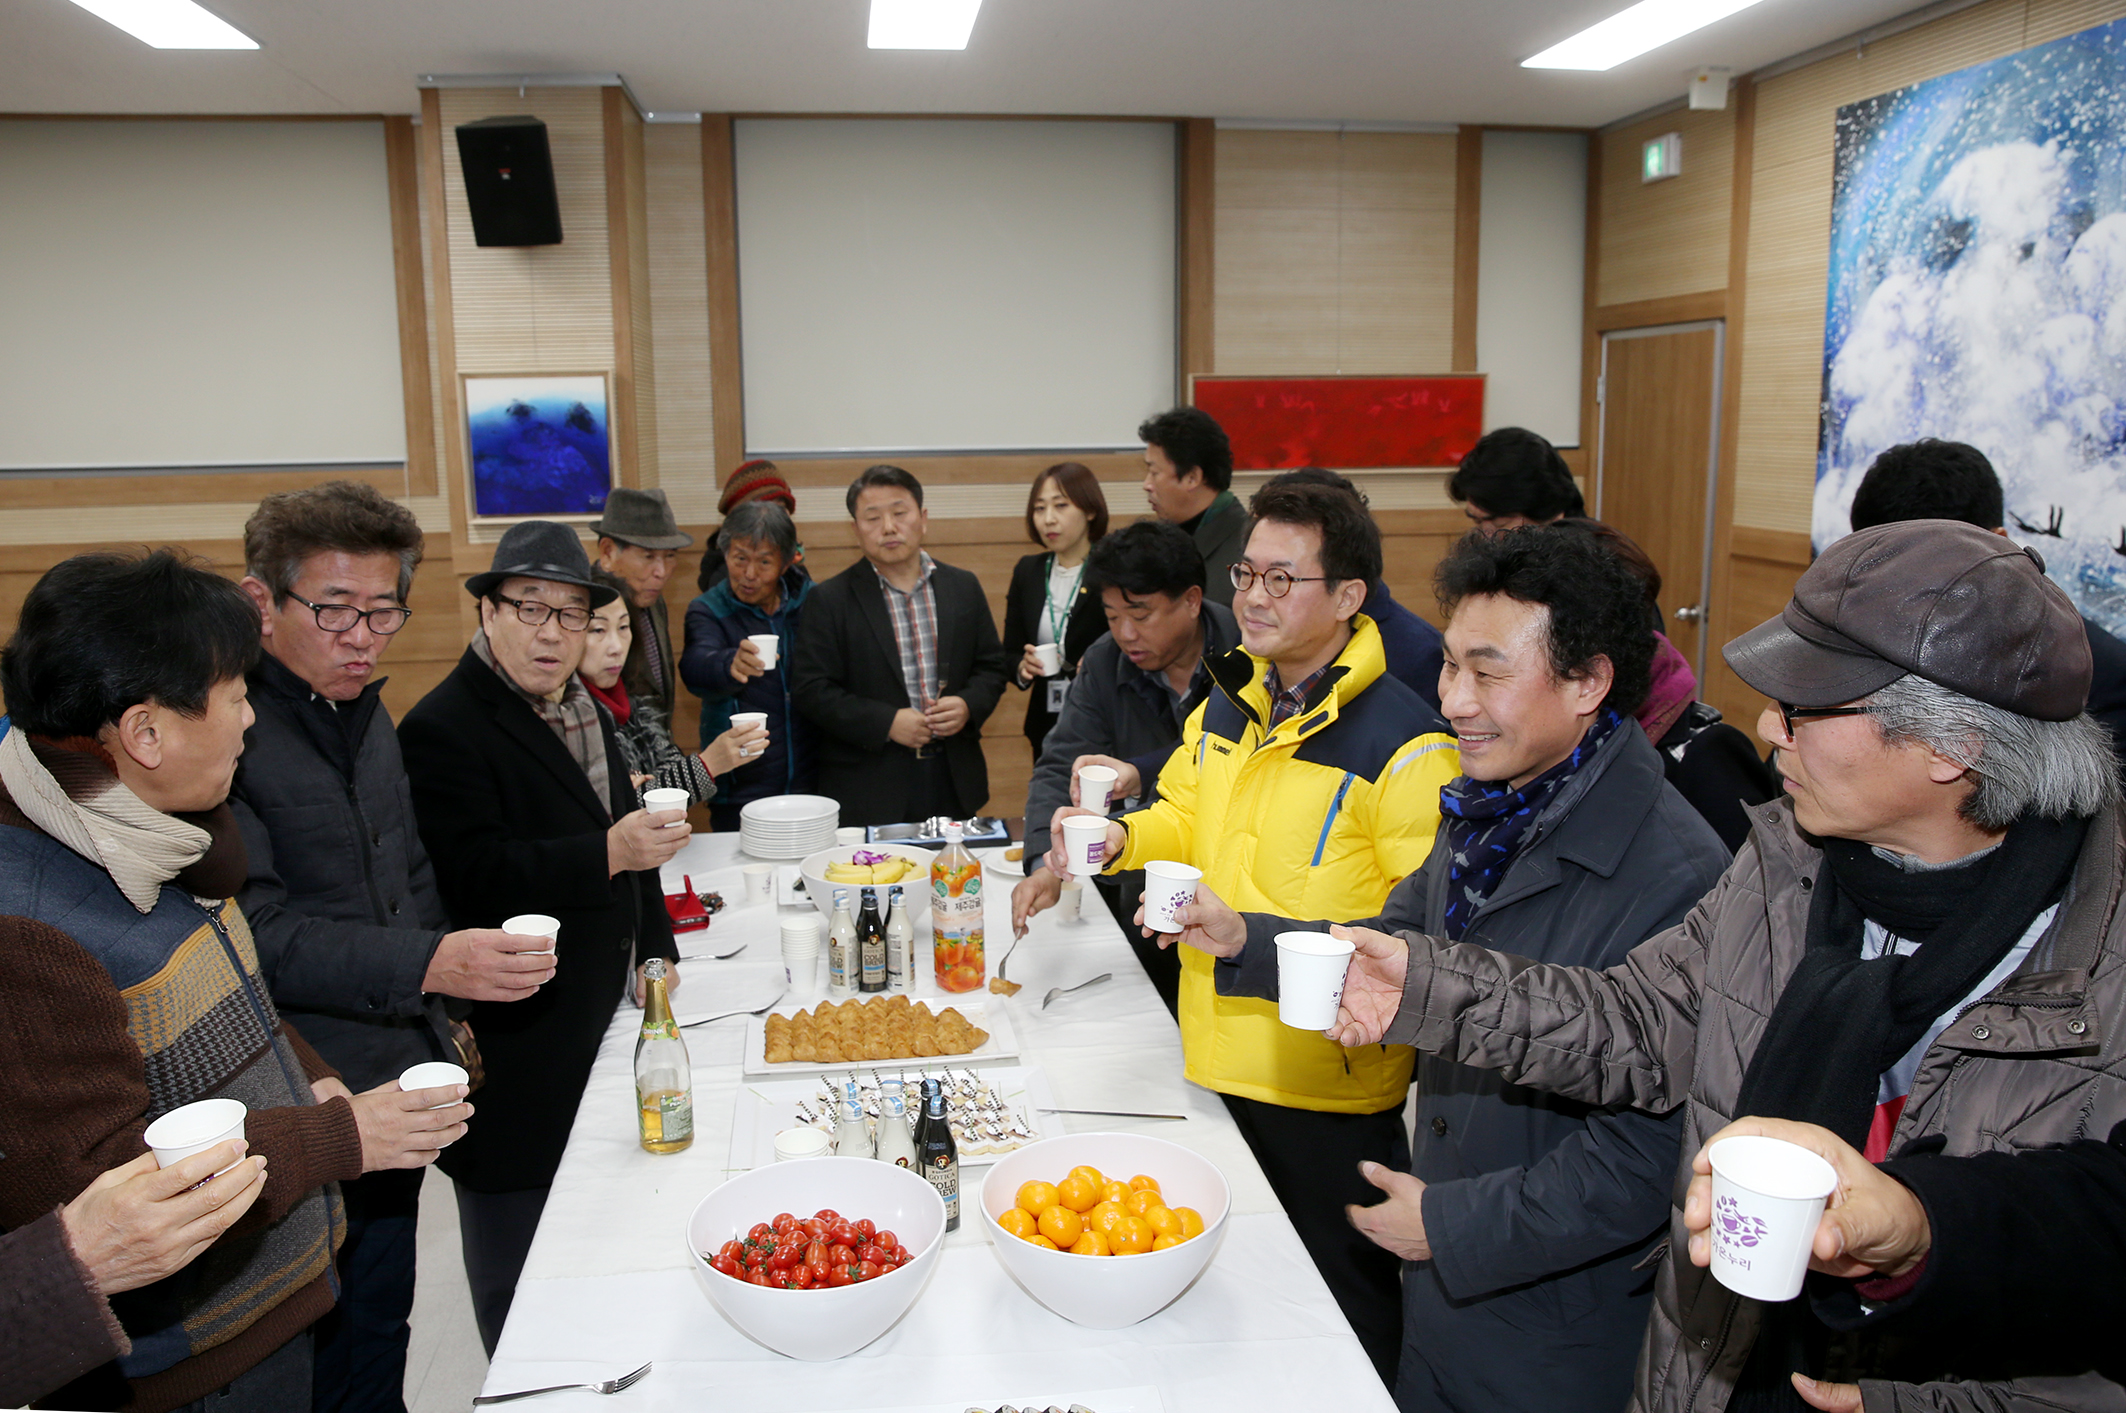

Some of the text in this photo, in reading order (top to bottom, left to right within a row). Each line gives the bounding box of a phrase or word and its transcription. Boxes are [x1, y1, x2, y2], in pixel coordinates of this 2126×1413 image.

[955, 897, 981, 911] 제주감귤
[864, 953, 884, 961] COLD
[928, 1172, 955, 1180] GOTICA
[939, 1186, 956, 1197] REW
[1712, 1239, 1751, 1271] 가온누리
